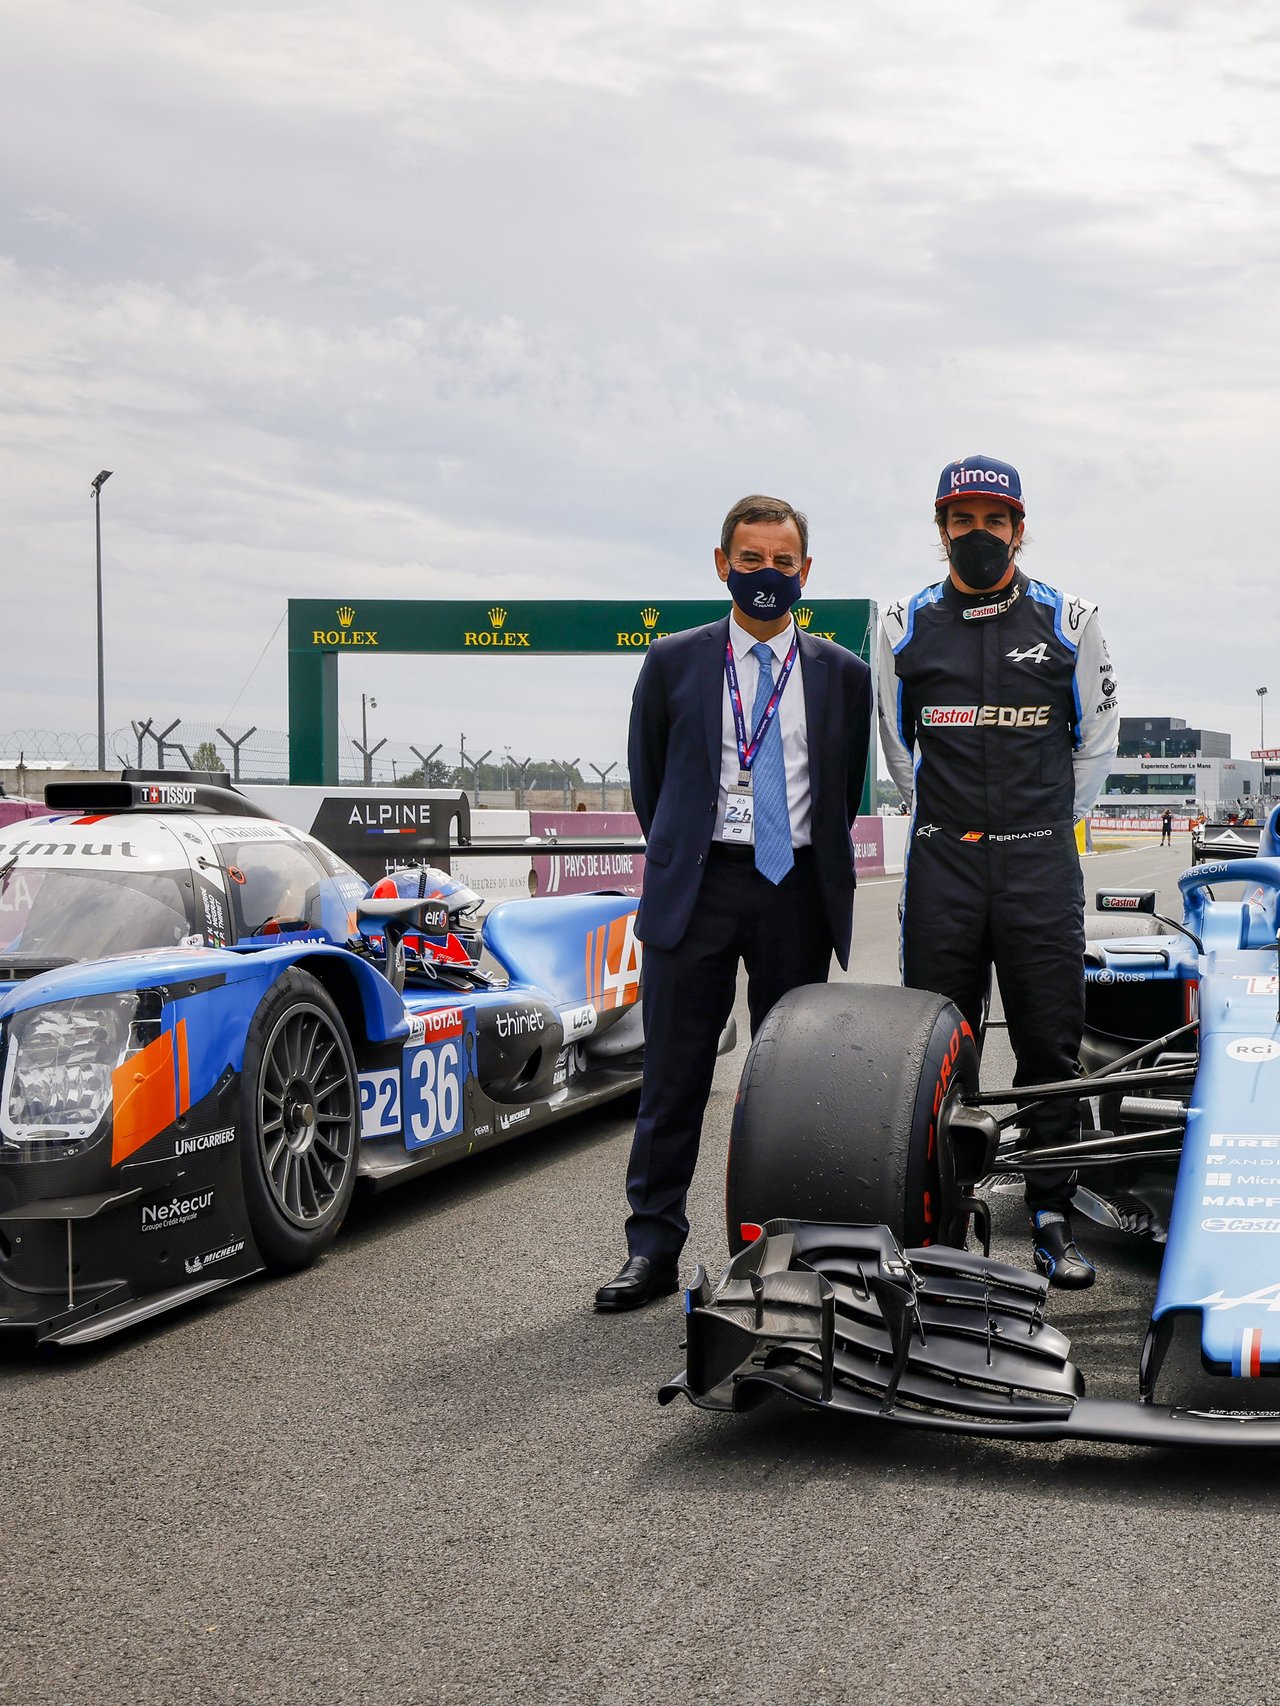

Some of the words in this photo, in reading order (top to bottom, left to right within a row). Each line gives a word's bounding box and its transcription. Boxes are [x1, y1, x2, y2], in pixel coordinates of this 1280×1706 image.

[951, 467, 1009, 489] kimoa
[972, 605, 997, 617] Castrol
[312, 631, 379, 645] ROLEX
[464, 631, 530, 647] ROLEX
[616, 632, 670, 646] ROL
[931, 707, 975, 724] Castrol
[976, 705, 1051, 727] EDGE
[160, 787, 197, 804] TISSOT
[348, 804, 431, 825] ALPINE
[989, 829, 1053, 842] FERNANDO
[0, 840, 138, 857] tmut
[564, 855, 586, 877] PAYS
[588, 855, 599, 876] DE
[600, 855, 611, 875] LA
[613, 854, 634, 875] LOIRE
[472, 878, 497, 889] HEURES
[498, 880, 507, 888] DU
[510, 877, 526, 888] MANS
[1110, 897, 1138, 907] Castrol
[425, 911, 440, 925] elf
[1084, 972, 1094, 983] ell
[1117, 973, 1146, 982] Ross
[423, 1011, 462, 1032] TOTAL
[495, 1008, 545, 1038] thiriet
[573, 1009, 592, 1029] WEC
[411, 1044, 459, 1142] 36
[175, 1129, 235, 1156] UNICARRIERS
[142, 1191, 214, 1224] Nexecur
[141, 1221, 163, 1232] Groupe
[163, 1218, 179, 1228] Crédit
[179, 1212, 198, 1224] Agricole
[203, 1240, 245, 1264] MICHELIN
